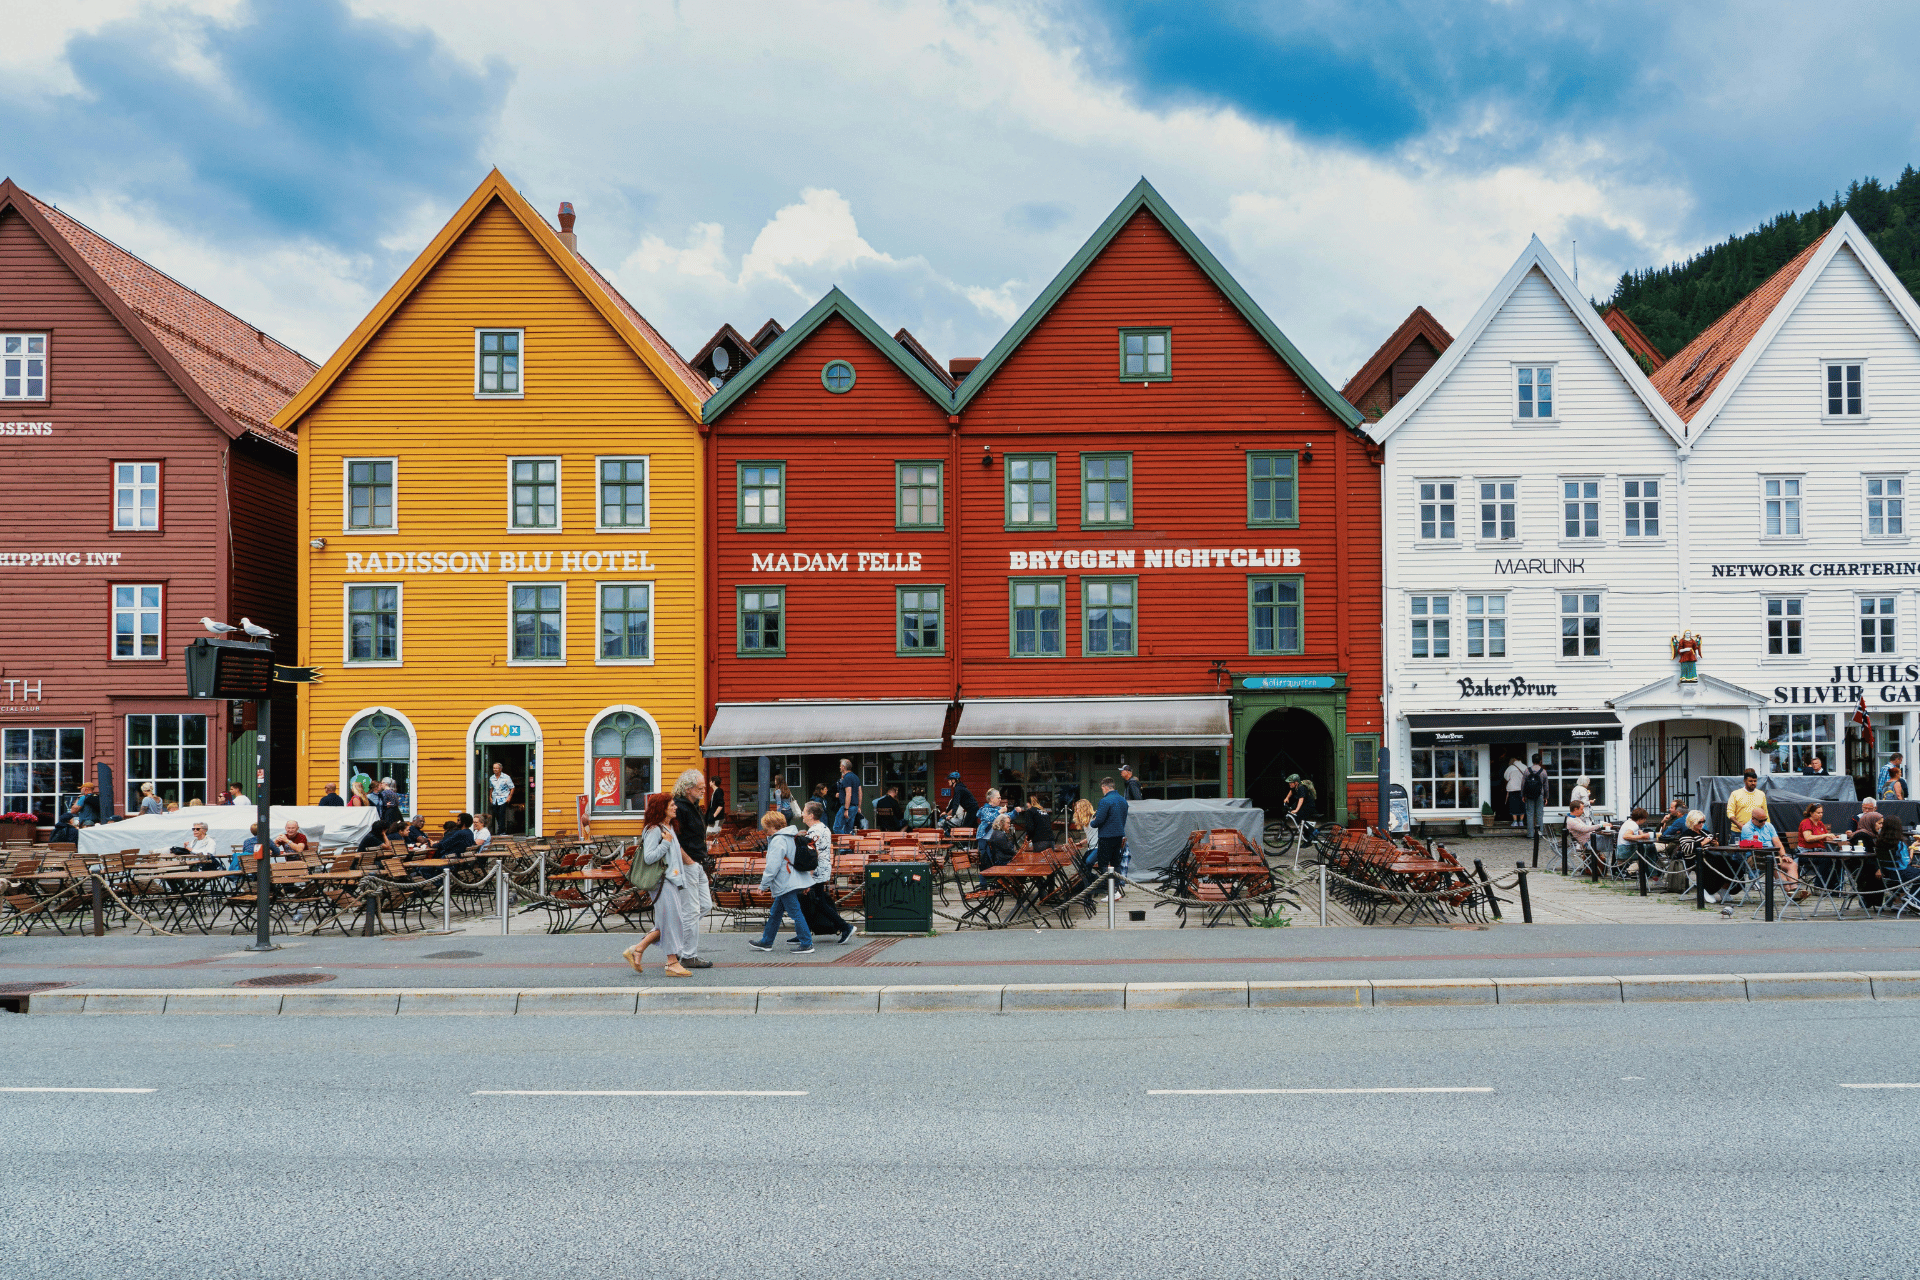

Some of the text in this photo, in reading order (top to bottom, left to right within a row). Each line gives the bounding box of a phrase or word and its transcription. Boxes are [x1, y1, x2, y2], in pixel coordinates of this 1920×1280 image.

[86, 552, 122, 566] INT
[345, 550, 655, 573] RADISSON BLU HOTEL
[751, 552, 922, 571] MADAM FELLE
[1009, 548, 1301, 570] BRYGGEN NIGHTCLUB
[1494, 558, 1585, 575] MARLINK
[1711, 562, 1920, 577] NETWORK CHARTERIN
[1830, 664, 1919, 684] JUHLS
[3, 679, 42, 702] TH
[1774, 685, 1864, 704] SILVER
[491, 724, 520, 736] MIX
